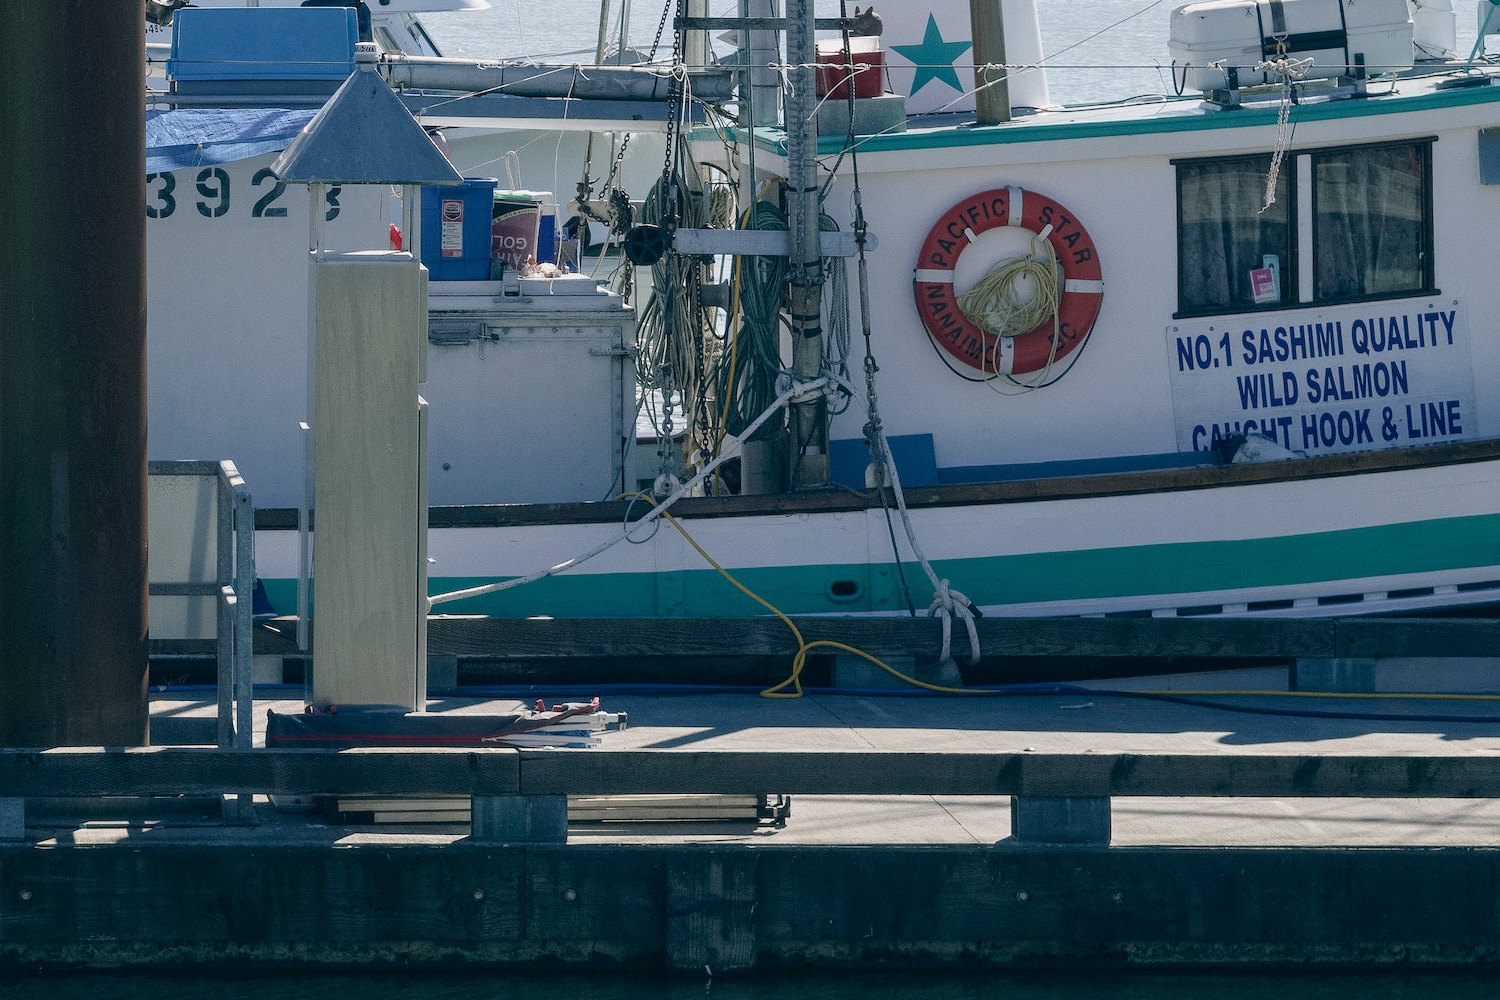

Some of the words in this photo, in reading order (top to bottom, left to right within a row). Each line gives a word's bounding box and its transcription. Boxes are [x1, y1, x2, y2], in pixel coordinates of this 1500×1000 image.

[931, 198, 1006, 267] PACIFIC
[1039, 206, 1091, 264] STAR
[927, 285, 1000, 365] NANAIMO
[1048, 322, 1077, 351] BC
[1176, 331, 1232, 371] NO.1
[1242, 321, 1344, 365] SASHIMI
[1351, 310, 1456, 356] QUALITY
[1237, 371, 1299, 410] WILD
[1307, 360, 1409, 403] SALMON
[1301, 409, 1374, 449] HOOK
[1382, 406, 1399, 441] &
[1406, 400, 1463, 439] LINE
